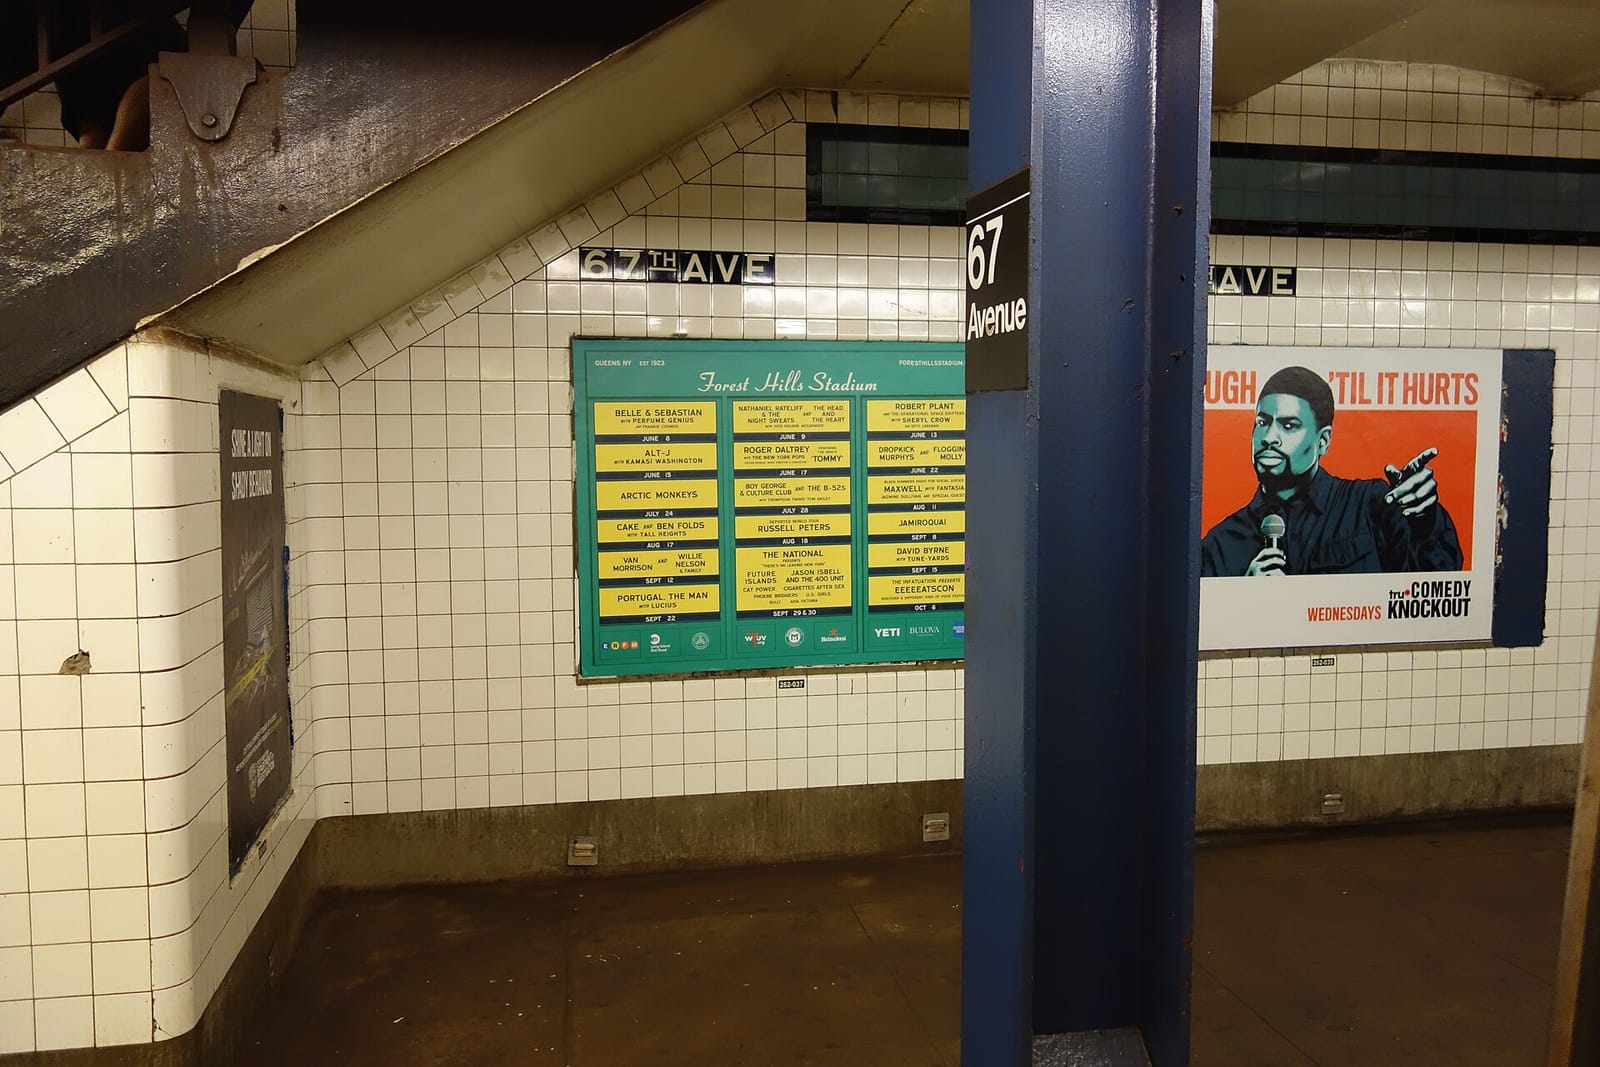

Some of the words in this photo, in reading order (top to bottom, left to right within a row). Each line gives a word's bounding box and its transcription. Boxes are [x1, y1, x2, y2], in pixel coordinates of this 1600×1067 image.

[968, 215, 1003, 290] 67
[682, 253, 770, 283] AVE
[1217, 267, 1293, 295] AVE
[967, 297, 1026, 340] Avenue
[698, 371, 750, 392] Forest
[755, 370, 804, 392] Hills
[808, 371, 878, 391] Stadium
[1205, 370, 1257, 404] UGH
[1328, 371, 1372, 405] 'TIL
[1377, 372, 1400, 405] IT
[1403, 372, 1479, 406] HURTS
[615, 409, 642, 417] BELLE
[654, 409, 703, 417] SEBASTIAN
[743, 446, 773, 454] ROGER
[775, 445, 810, 453] DALTREY
[884, 485, 923, 493] MAXWELL
[655, 491, 698, 499] MONKEYS
[616, 523, 639, 531] CAKE
[898, 519, 947, 527] JAMIROQUAI
[758, 524, 795, 532] RUSSELL
[763, 551, 779, 559] THE
[782, 550, 824, 558] NATIONAL
[896, 547, 920, 555] DAVID
[678, 552, 703, 560] WILLIE
[613, 564, 653, 572] MORRISON
[675, 560, 706, 568] NELSON
[895, 585, 955, 594] EEEEEATSCON
[1389, 590, 1406, 600] tru
[1411, 580, 1472, 599] COMEDY
[617, 594, 666, 602] PORTUGAL.
[1387, 598, 1471, 619] KNOCKOUT
[1307, 605, 1382, 622] WEDNESDAYS
[874, 628, 900, 638] YETI
[909, 626, 940, 635] BULOVA
